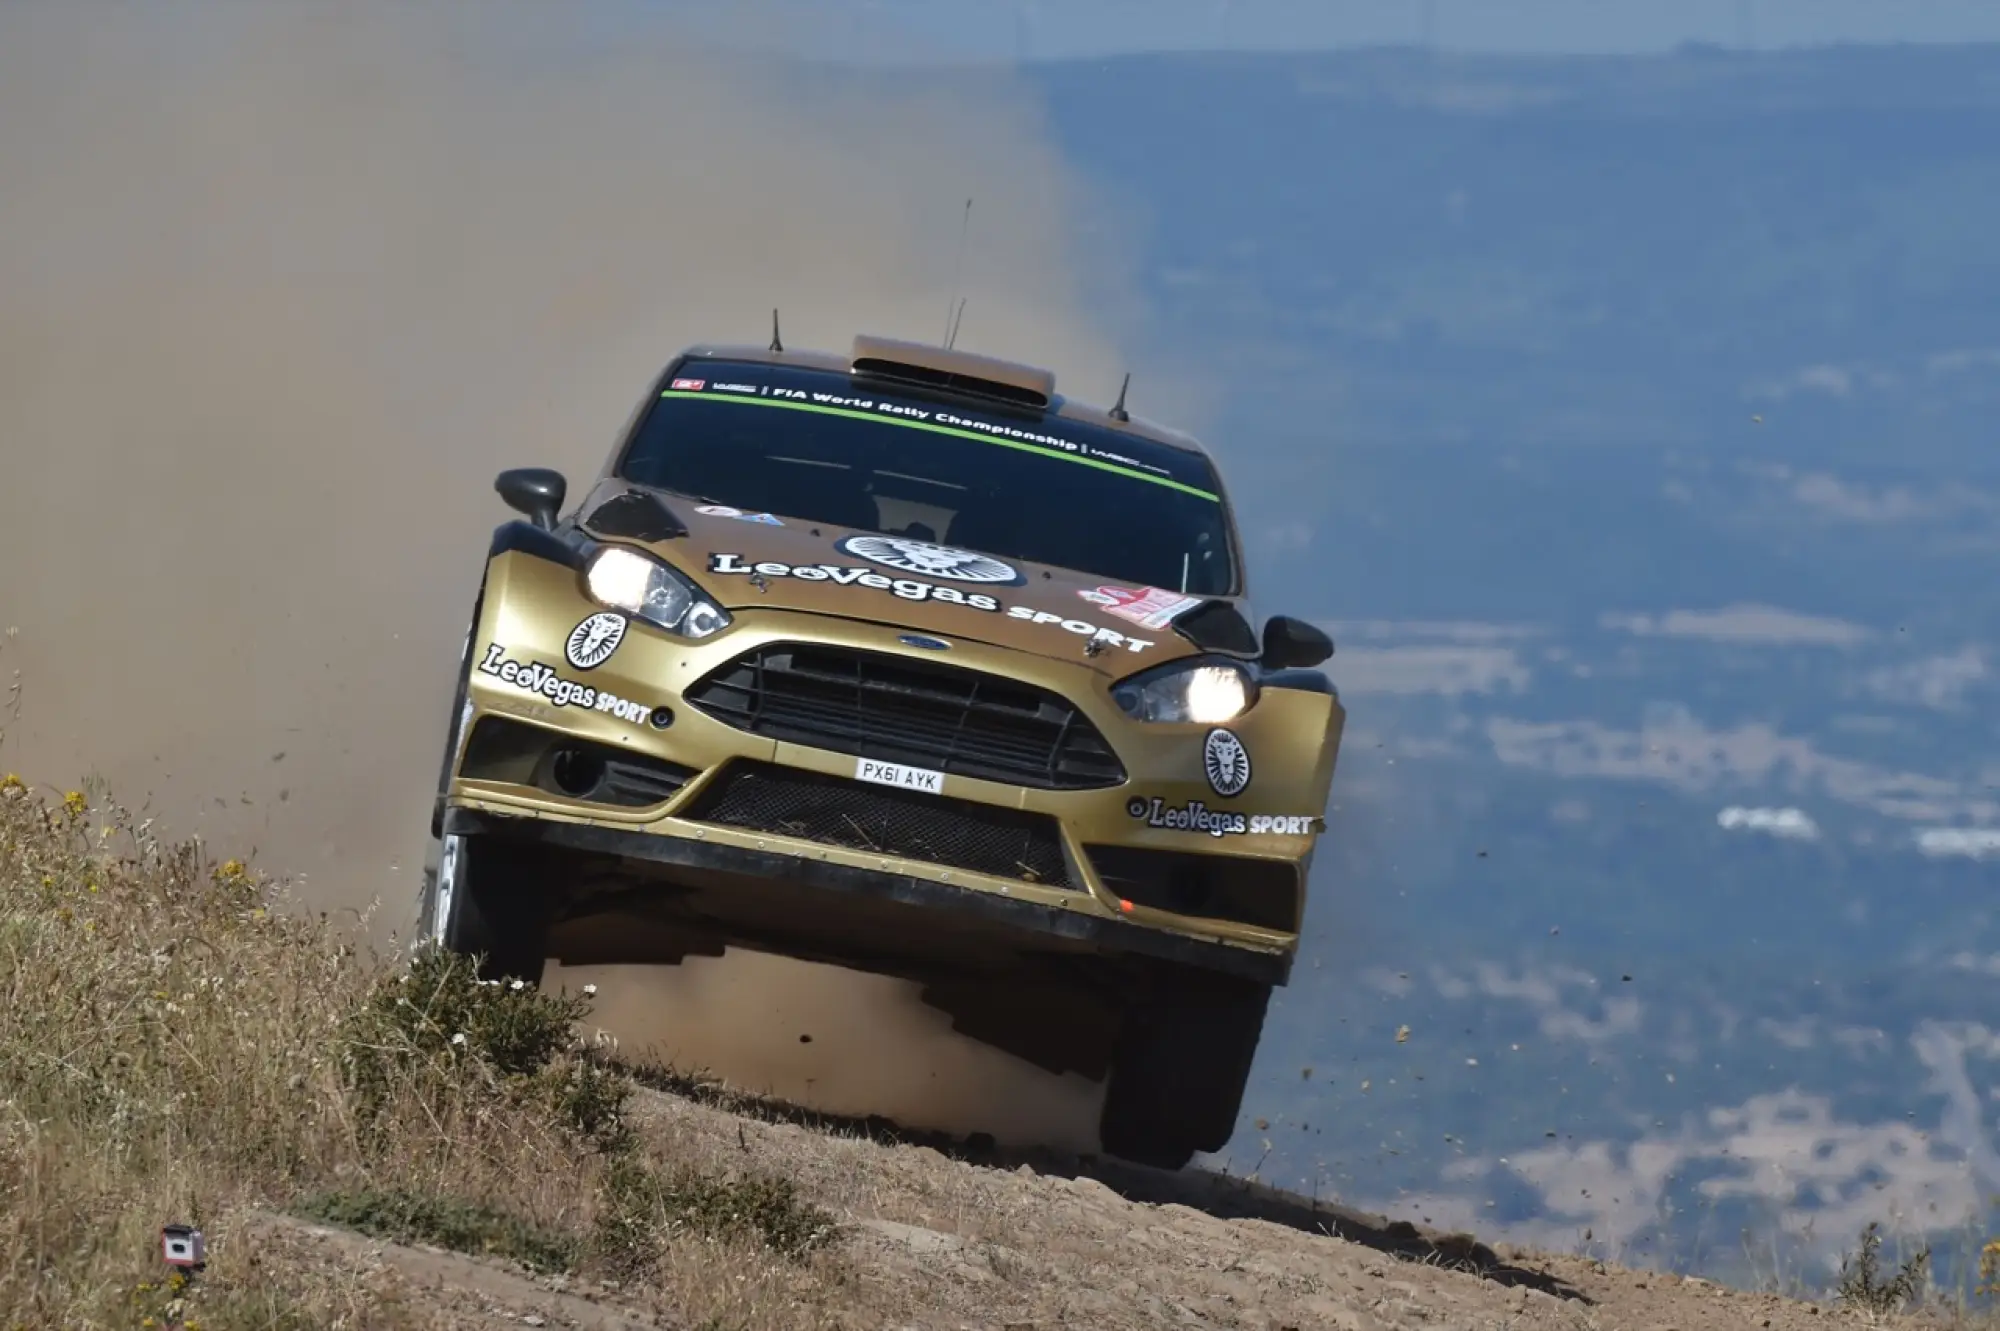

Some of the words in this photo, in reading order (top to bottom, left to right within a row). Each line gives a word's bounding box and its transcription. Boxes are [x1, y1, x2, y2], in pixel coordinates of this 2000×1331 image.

[773, 388, 807, 399] FIA
[812, 392, 873, 408] World
[878, 403, 930, 419] Rally
[935, 413, 1078, 451] Championship
[711, 553, 1000, 611] LeoVegas
[1006, 605, 1155, 653] SPORT
[479, 643, 596, 708] LeoVegas
[595, 691, 652, 724] SPORT
[863, 763, 900, 783] PX61
[904, 771, 937, 790] AYK
[1149, 798, 1246, 837] LeoVegas
[1250, 815, 1315, 835] SPORT
